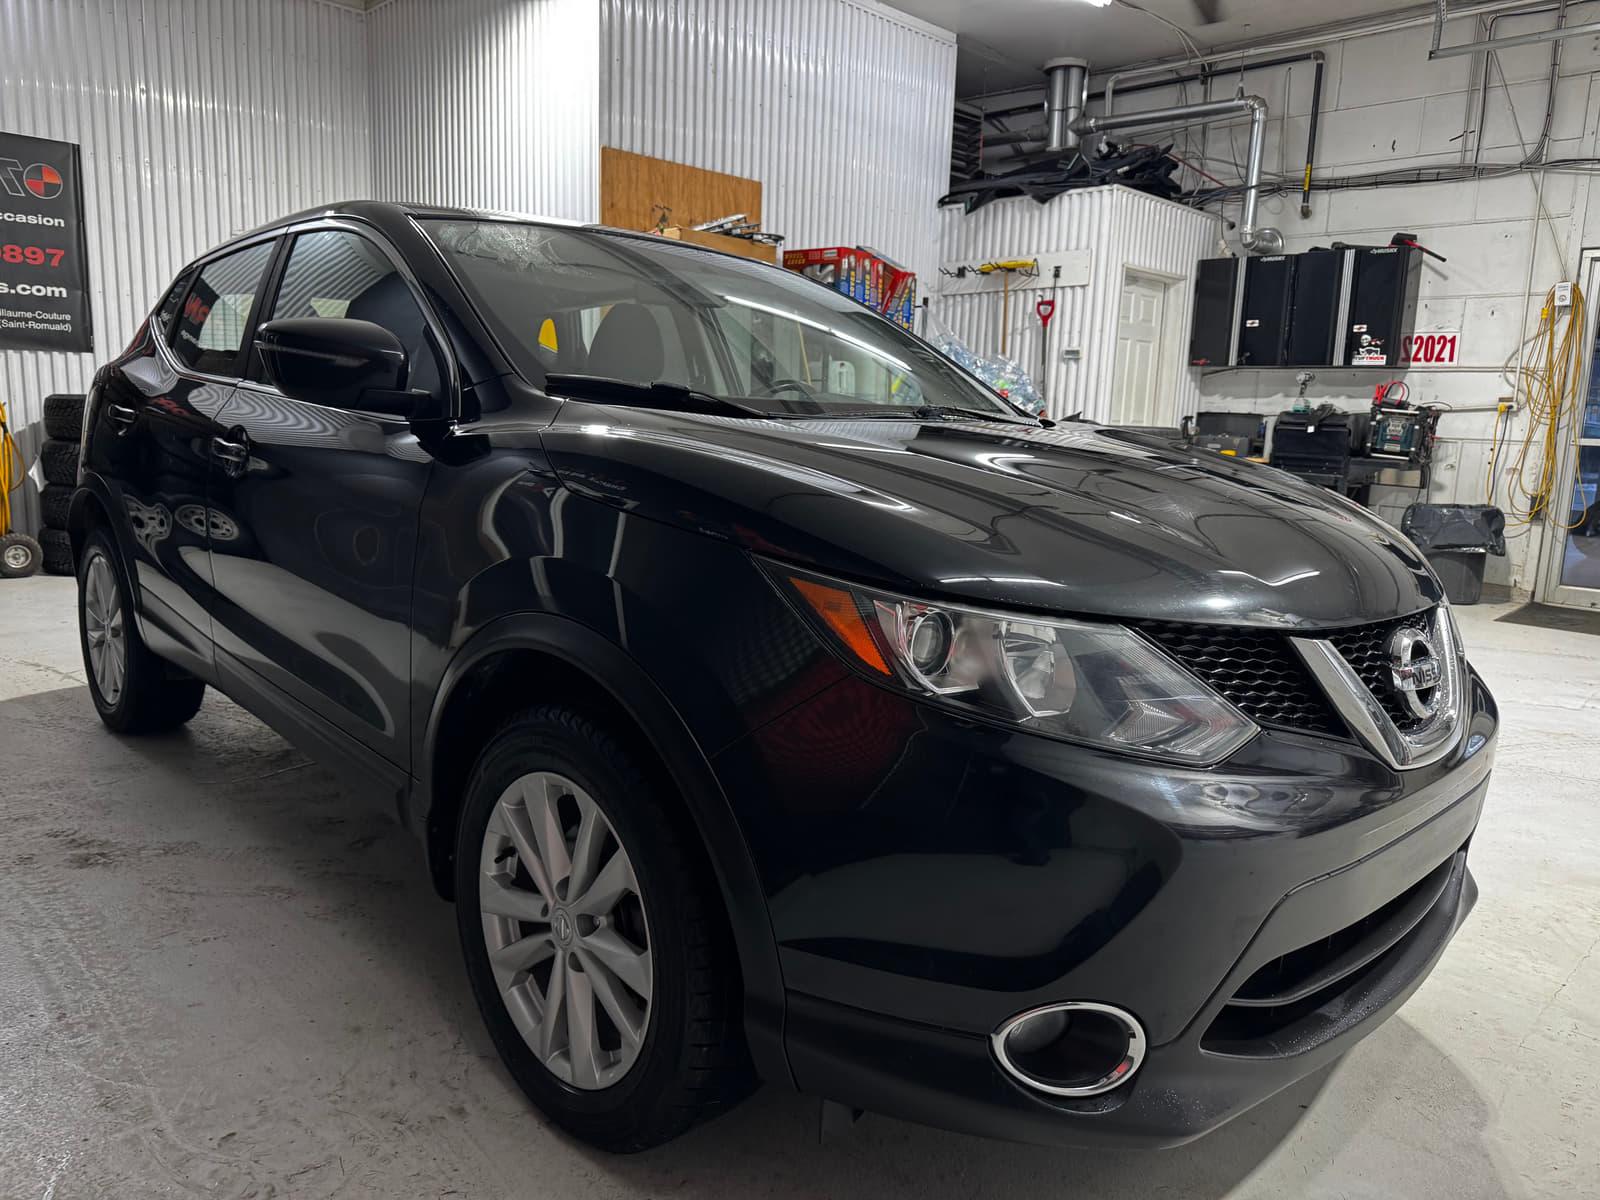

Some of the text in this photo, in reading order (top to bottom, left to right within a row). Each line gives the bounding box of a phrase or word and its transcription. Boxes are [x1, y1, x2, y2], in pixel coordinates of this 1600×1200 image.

[0, 212, 65, 227] casion
[0, 244, 65, 267] 897
[0, 282, 67, 298] s.com
